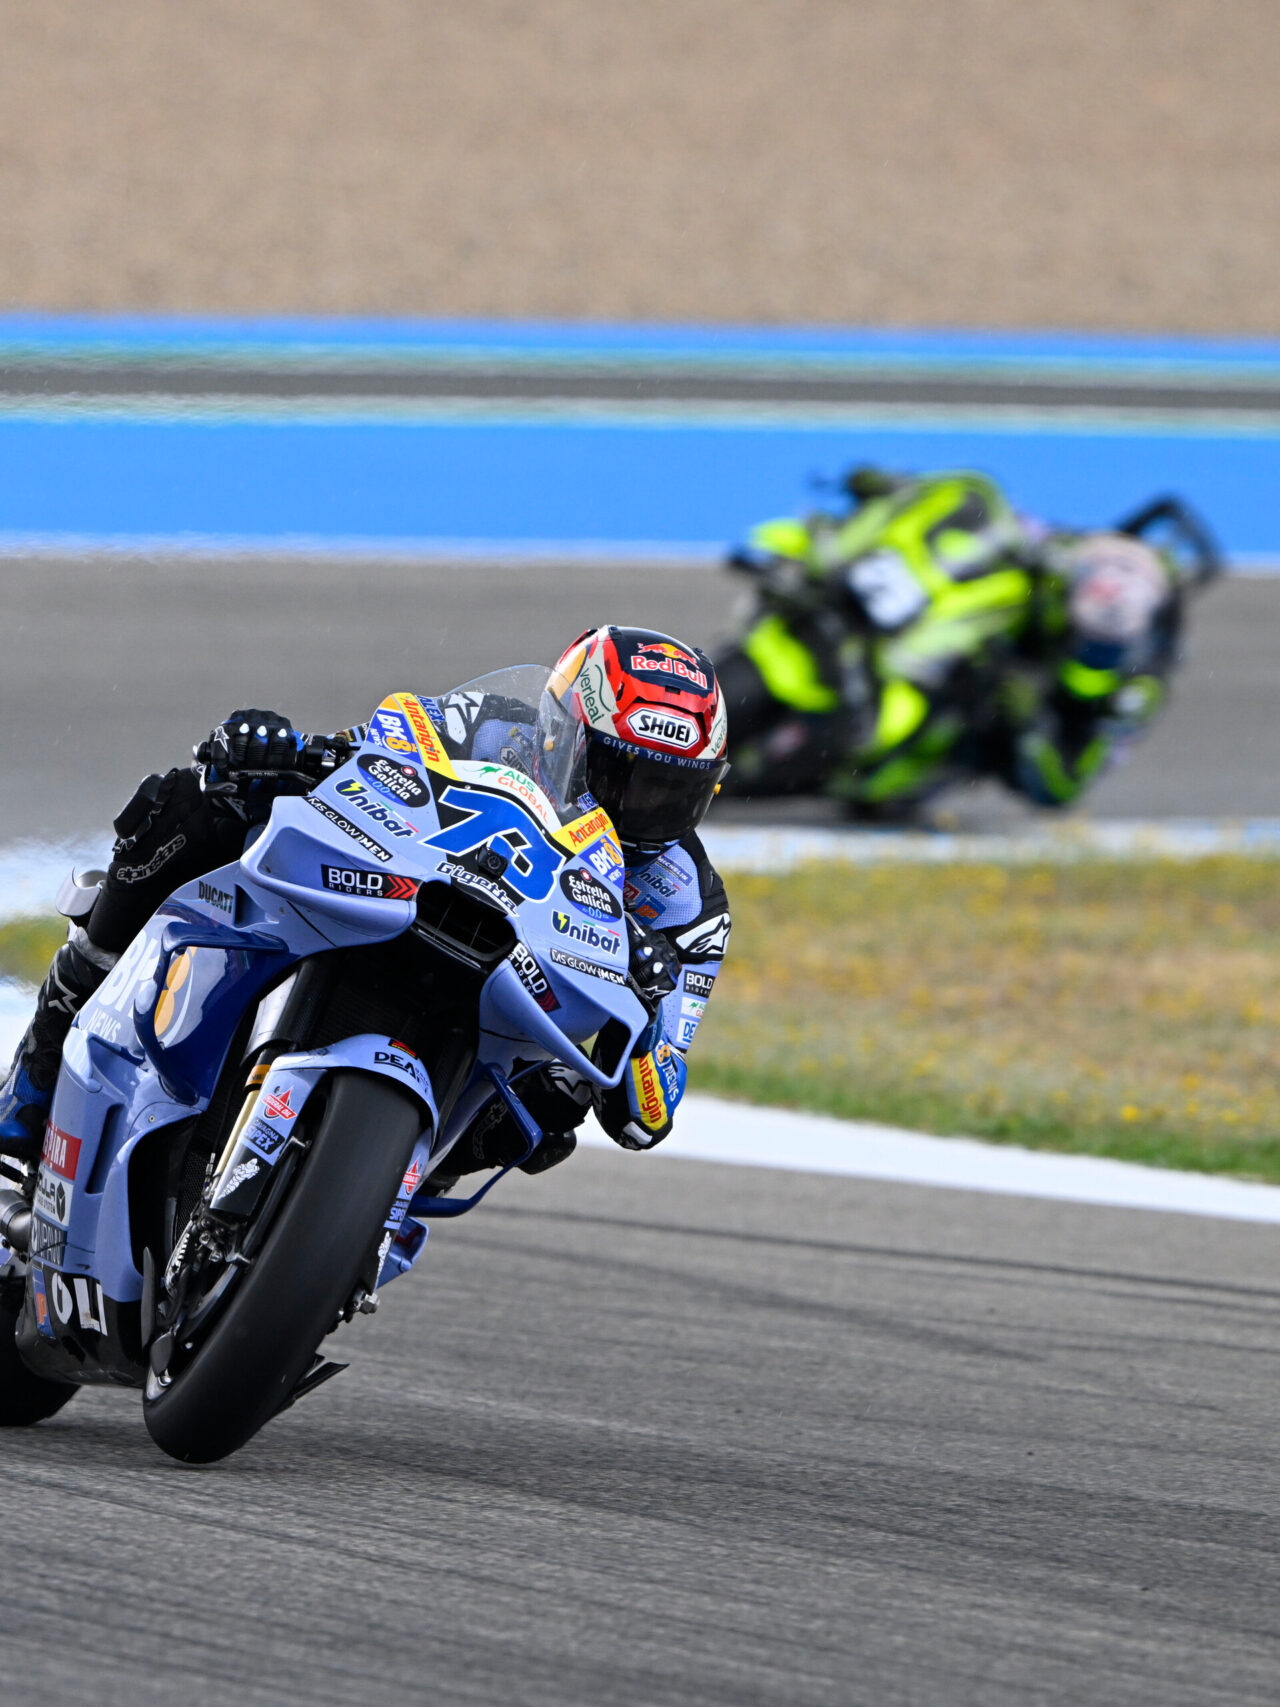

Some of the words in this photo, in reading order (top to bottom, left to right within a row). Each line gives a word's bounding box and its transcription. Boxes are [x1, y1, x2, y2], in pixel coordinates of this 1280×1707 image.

[631, 655, 672, 673] Red
[673, 659, 708, 689] Bull
[377, 713, 418, 753] BK8
[402, 698, 441, 763] Antangin
[638, 714, 690, 744] SHOEI
[603, 736, 640, 755] GIVES
[646, 750, 671, 764] YOU
[677, 757, 711, 770] WINGS
[368, 764, 412, 800] Galicia
[373, 759, 422, 796] Estrella
[504, 769, 536, 793] AUS
[308, 796, 325, 812] MS
[324, 808, 360, 840] GLOW
[335, 778, 415, 838] Unibat
[497, 776, 549, 824] GLOBAL
[417, 785, 567, 903] 73
[568, 811, 609, 847] Antangin
[589, 838, 623, 875] BK8
[607, 867, 622, 882] NEWS
[328, 867, 383, 890] BOLD
[328, 882, 384, 897] RIDERS
[435, 861, 518, 913] Gigetta
[569, 875, 611, 902] Estrella
[198, 880, 234, 914] DUCATI
[572, 888, 613, 914] Galicia
[551, 909, 621, 956] Unibat
[513, 942, 548, 994] BOLD
[551, 949, 567, 965] MS
[566, 957, 598, 976] GLOW
[686, 973, 713, 990] BOLD
[85, 1007, 121, 1043] NEWS
[663, 1066, 680, 1103] NEWS
